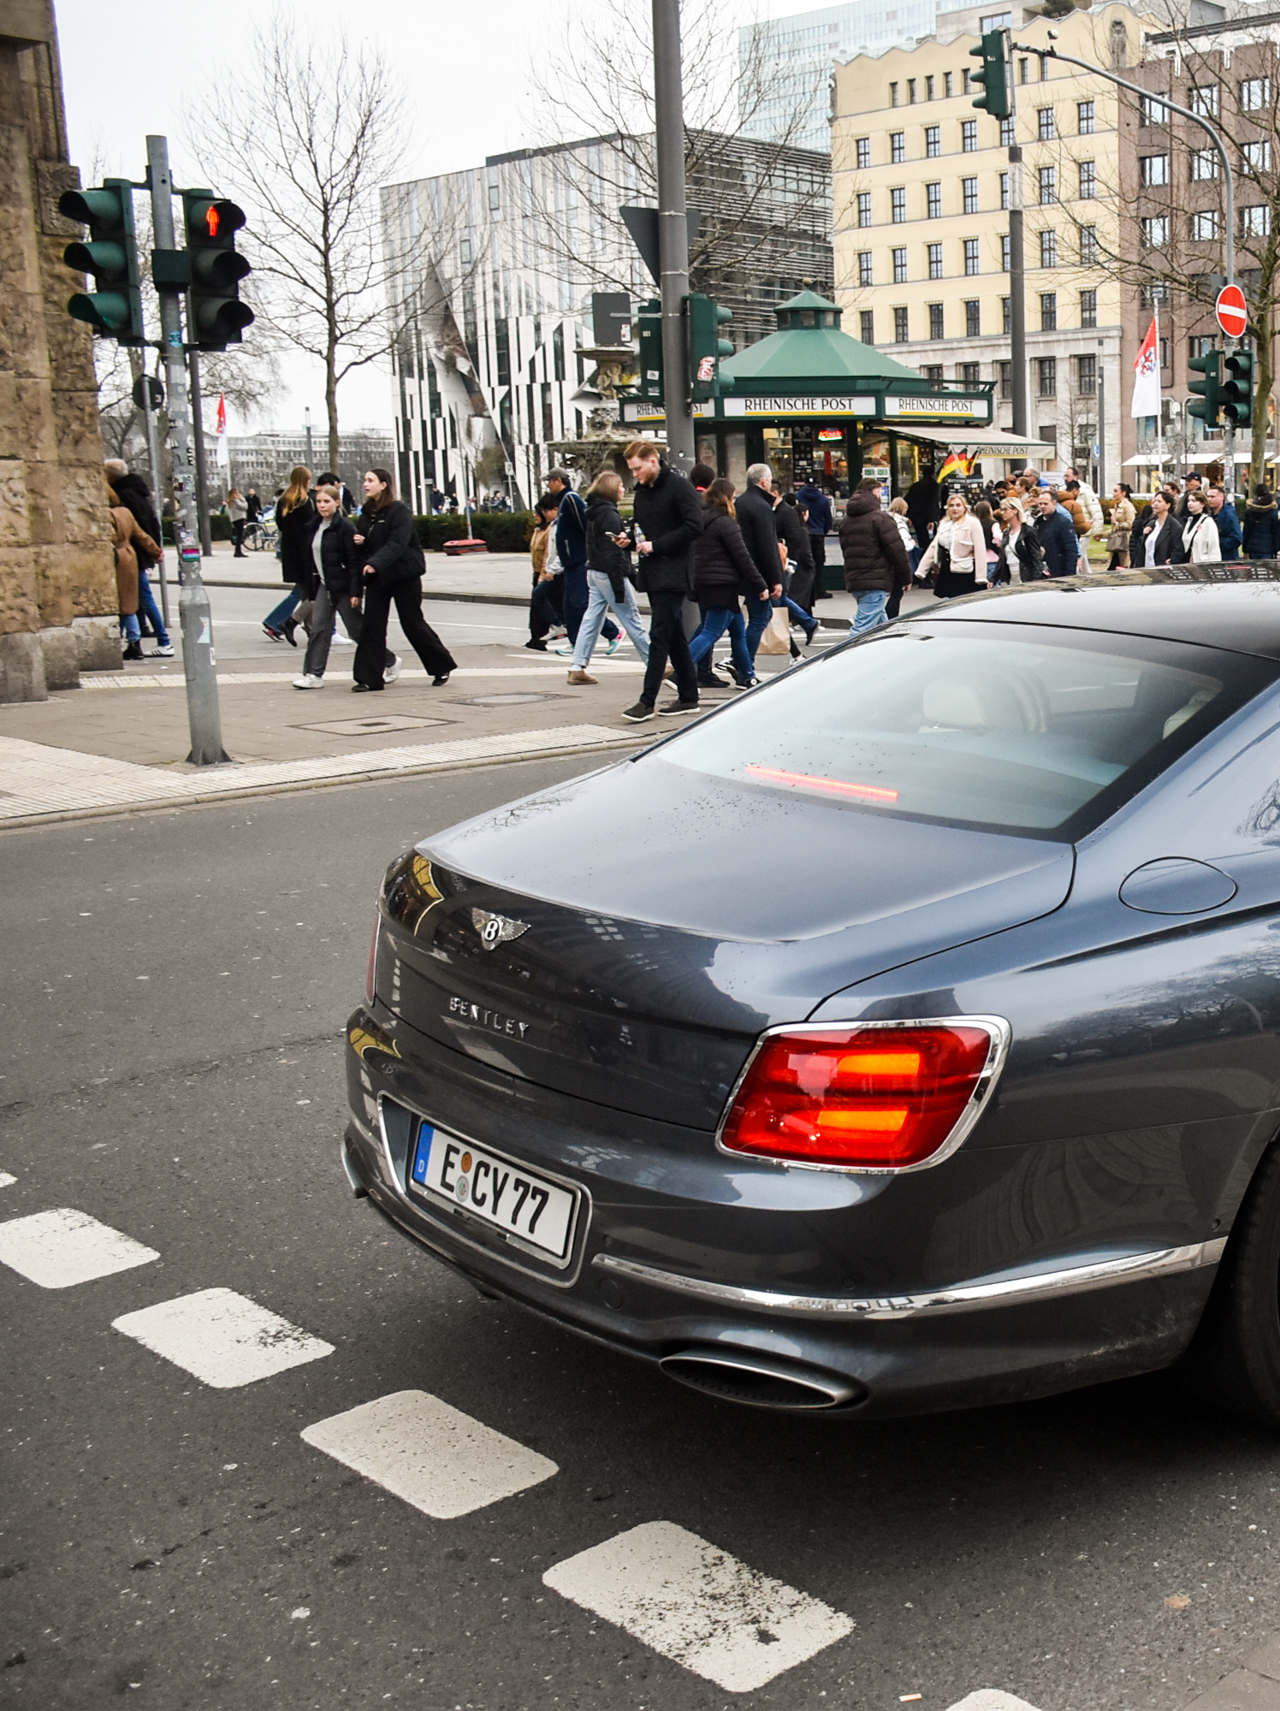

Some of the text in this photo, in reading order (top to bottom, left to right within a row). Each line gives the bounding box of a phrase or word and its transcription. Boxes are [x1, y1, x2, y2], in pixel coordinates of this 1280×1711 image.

[744, 398, 855, 411] RHEINISCHE POST
[899, 398, 975, 412] RHEINISCHE POST
[1013, 446, 1029, 455] POST
[450, 997, 530, 1039] BENTLEY
[418, 1159, 425, 1174] D
[440, 1143, 550, 1235] E CY 77
